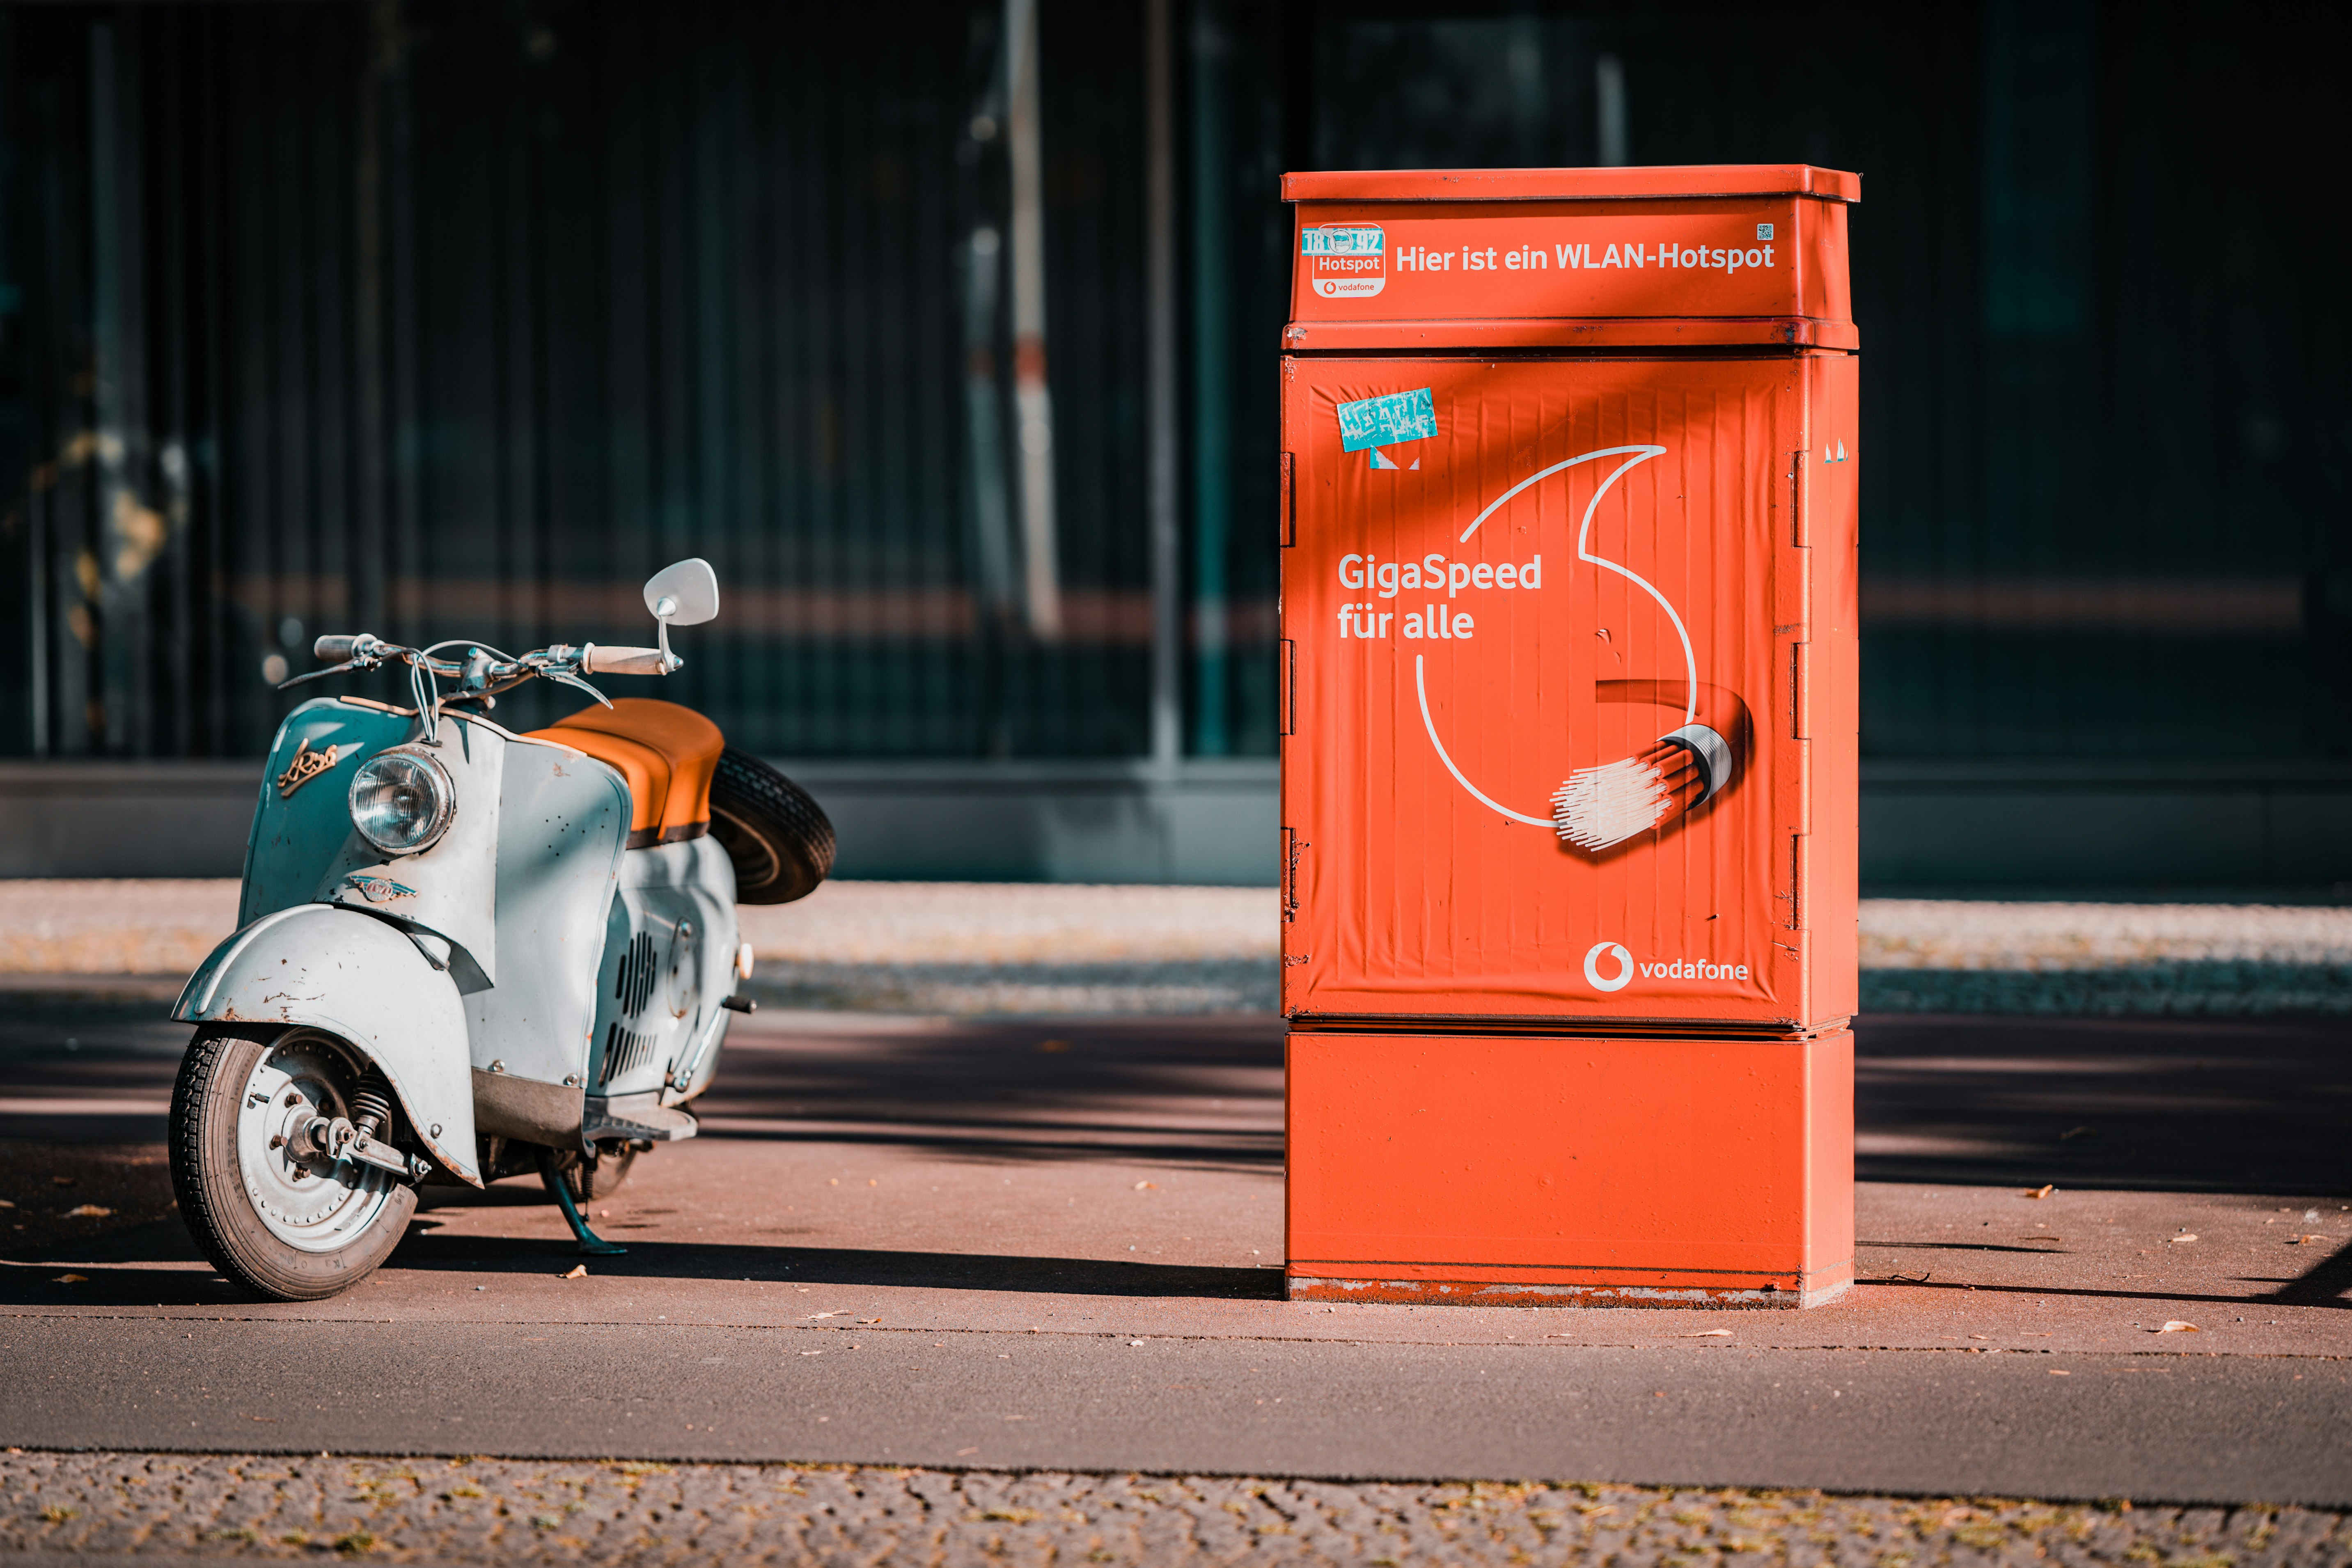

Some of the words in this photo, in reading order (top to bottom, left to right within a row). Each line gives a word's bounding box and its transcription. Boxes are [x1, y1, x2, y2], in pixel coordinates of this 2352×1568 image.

[1319, 257, 1380, 273] Hotspot
[1397, 247, 1455, 271] Hier
[1463, 246, 1497, 270] ist
[1505, 245, 1547, 269] ein
[1556, 243, 1774, 274] WLAN-Hotspot
[1339, 554, 1541, 598] GigaSpeed
[1337, 603, 1393, 639] für
[1403, 604, 1474, 639] alle
[1639, 958, 1748, 980] vodafone
